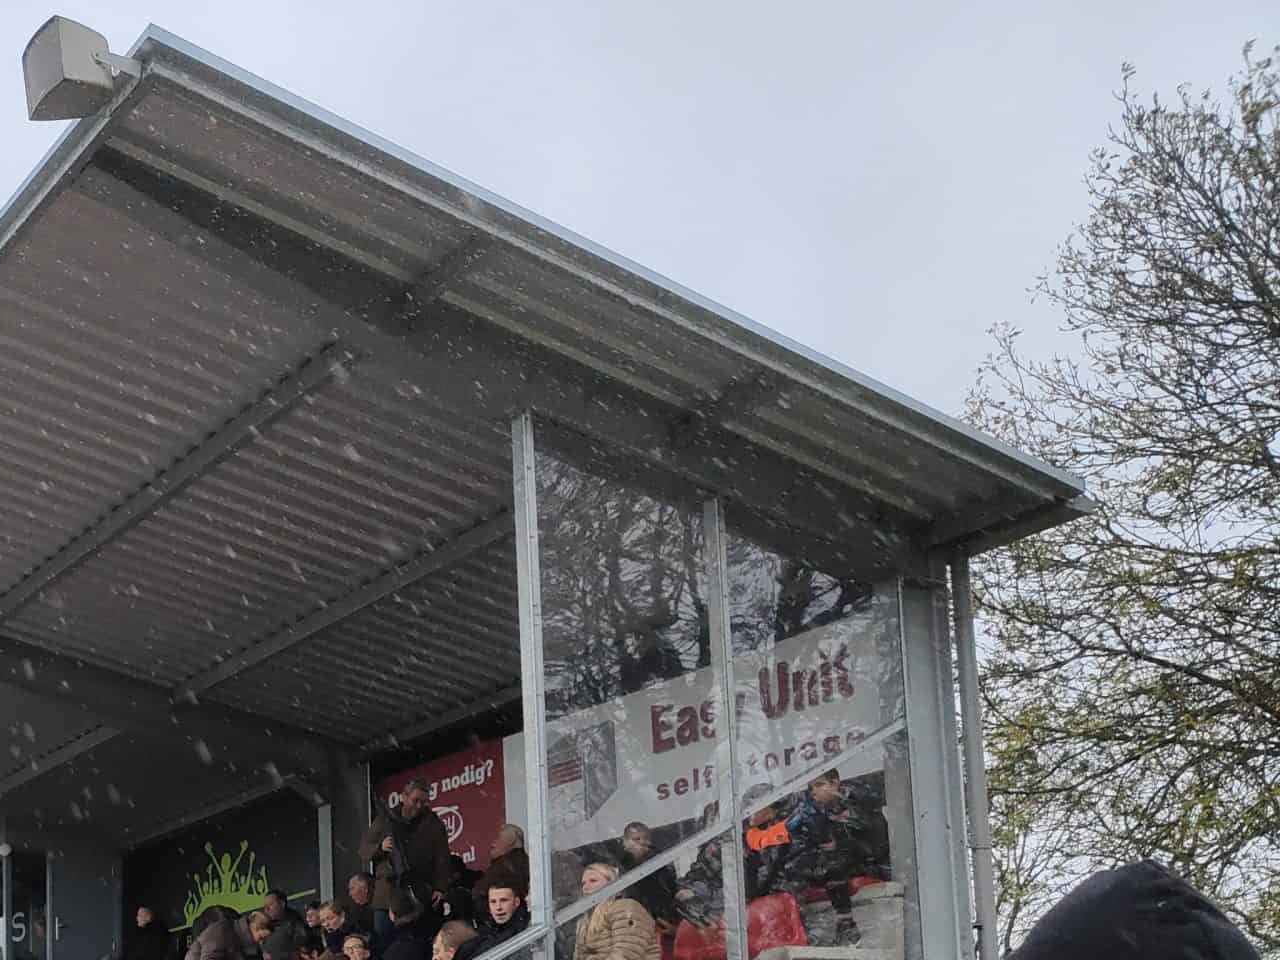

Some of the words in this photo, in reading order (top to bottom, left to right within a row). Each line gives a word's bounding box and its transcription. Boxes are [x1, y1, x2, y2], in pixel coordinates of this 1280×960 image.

[759, 643, 855, 720] Unit
[441, 759, 494, 792] nodig?
[656, 764, 714, 800] self
